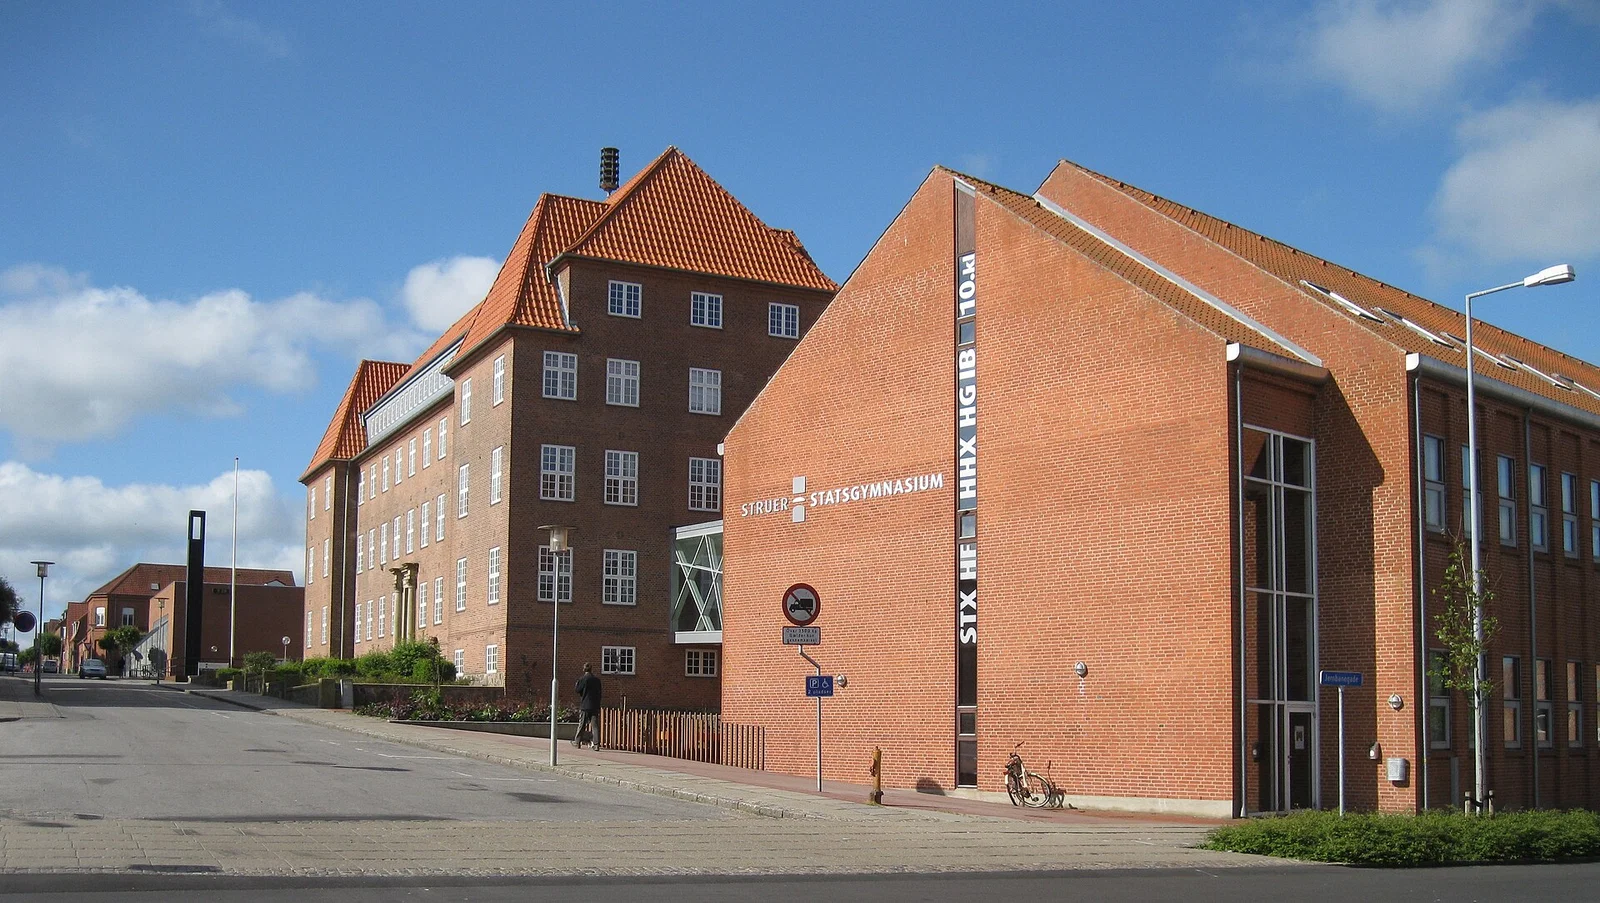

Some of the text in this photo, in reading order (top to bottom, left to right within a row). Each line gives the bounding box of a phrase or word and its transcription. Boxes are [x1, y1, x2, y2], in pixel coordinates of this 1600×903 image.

[959, 253, 976, 644] STX HF HHX HG IB 10.kl
[741, 497, 789, 517] STRUER
[810, 473, 944, 507] STATSGYMNASIUM
